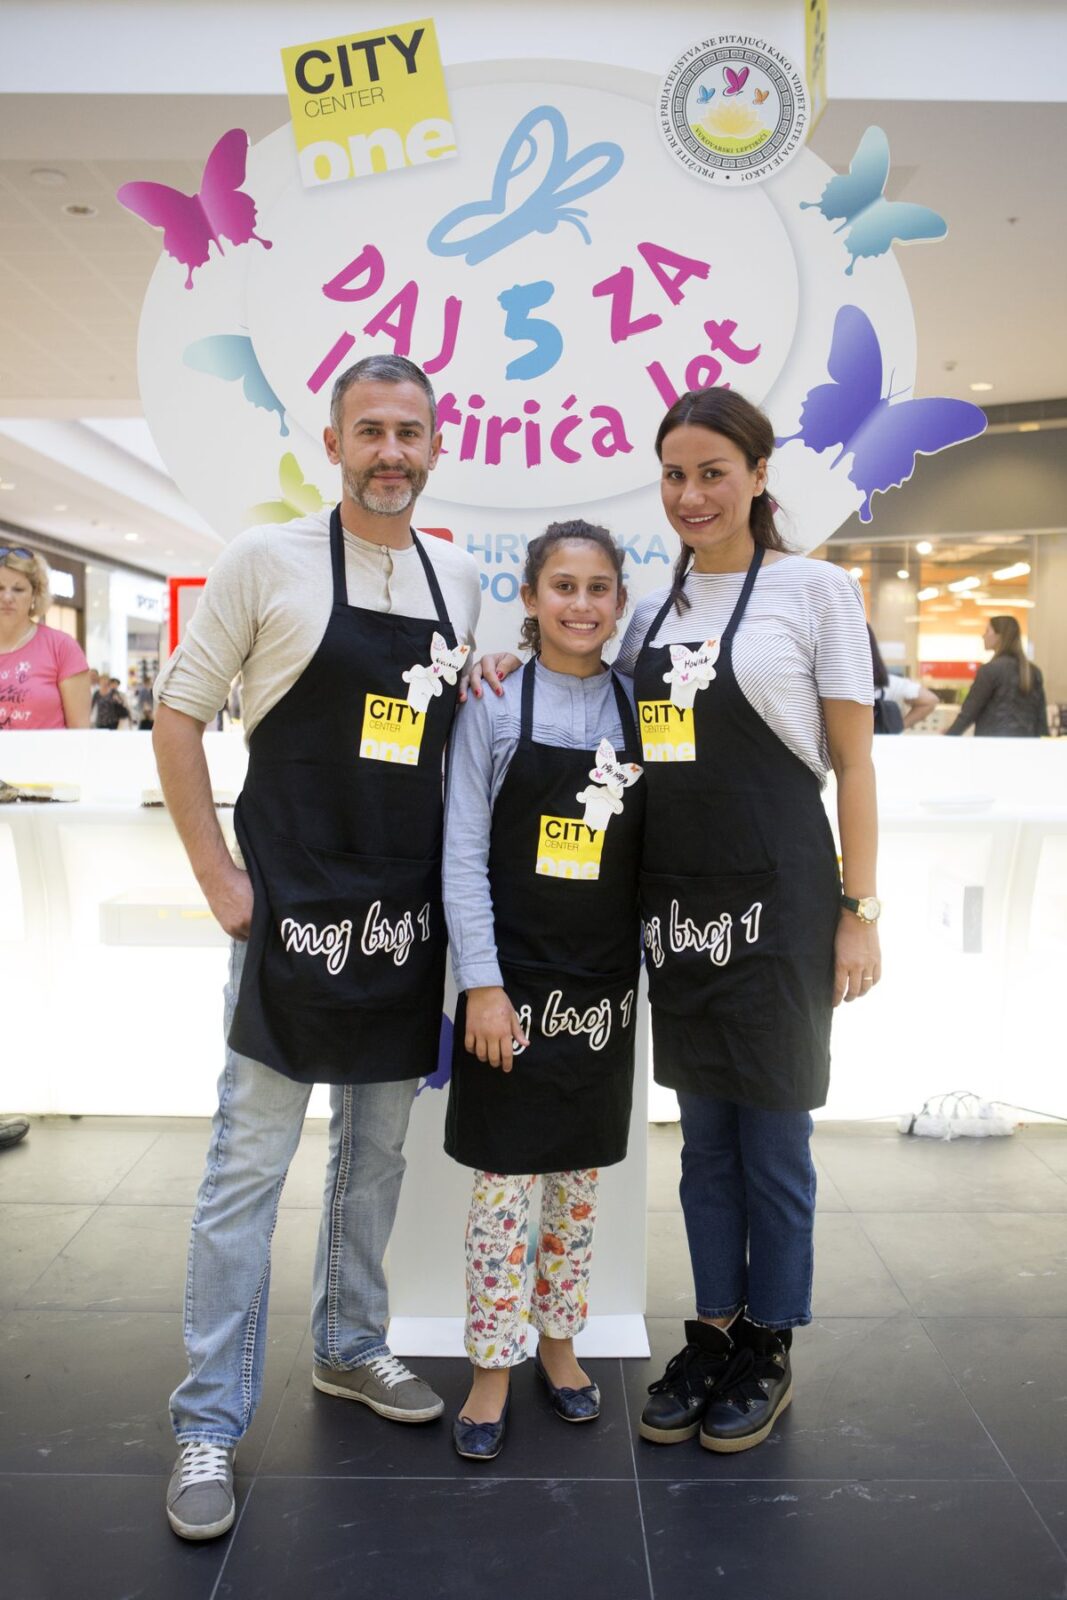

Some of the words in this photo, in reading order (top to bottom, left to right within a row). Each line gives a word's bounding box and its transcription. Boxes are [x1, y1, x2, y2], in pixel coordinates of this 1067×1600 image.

[701, 38, 717, 49] NE
[718, 35, 767, 50] PITAJUĆI
[295, 28, 425, 94] CITY
[767, 46, 793, 75] KAKO,
[660, 46, 701, 117] PRIJATELJSTVA
[791, 73, 806, 111] VIDJET
[304, 86, 385, 118] CENTER
[661, 119, 678, 148] RUKE
[299, 117, 458, 188] one
[675, 148, 715, 179] PRUŽITE
[741, 163, 773, 181] LAKO!
[322, 244, 463, 374] DAJ
[497, 280, 564, 381] 5
[592, 241, 712, 344] ZA
[645, 318, 762, 411] let
[369, 720, 401, 733] CENTER
[370, 699, 420, 725] CITY
[642, 704, 686, 723] CITY
[644, 725, 671, 733] CENTER
[360, 738, 419, 766] one
[643, 742, 697, 762] one
[544, 840, 579, 852] CENTER
[545, 820, 598, 843] CITY
[535, 856, 600, 880] one
[281, 917, 353, 975] moj
[361, 900, 415, 966] broj
[417, 902, 431, 942] 1
[669, 898, 733, 967] broj
[740, 901, 763, 944] 1
[541, 990, 612, 1051] broj
[620, 989, 634, 1029] 1
